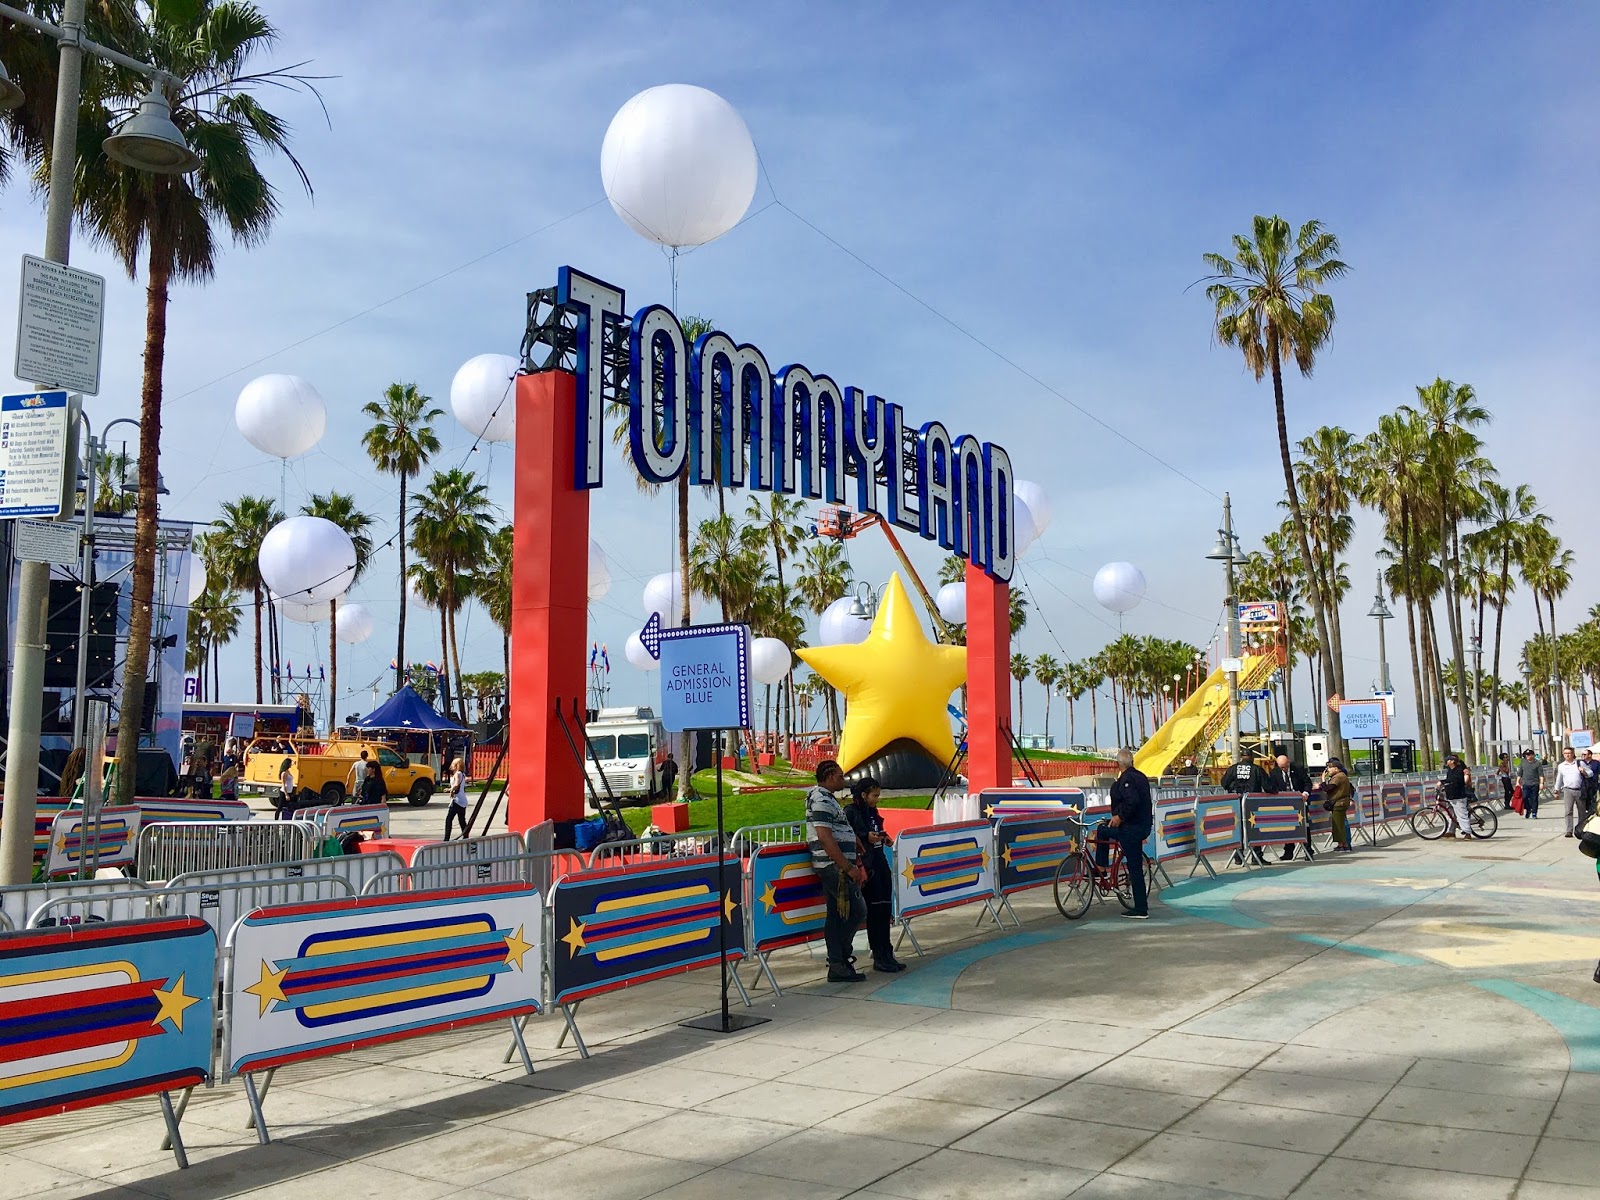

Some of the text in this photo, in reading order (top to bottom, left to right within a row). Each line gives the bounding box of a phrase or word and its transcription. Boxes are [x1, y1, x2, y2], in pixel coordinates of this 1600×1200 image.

[42, 265, 57, 273] HOURS
[558, 265, 1014, 584] TOMMYLAND
[672, 663, 725, 677] GENERAL
[667, 676, 731, 691] ADMISSION
[685, 691, 713, 704] BLUE
